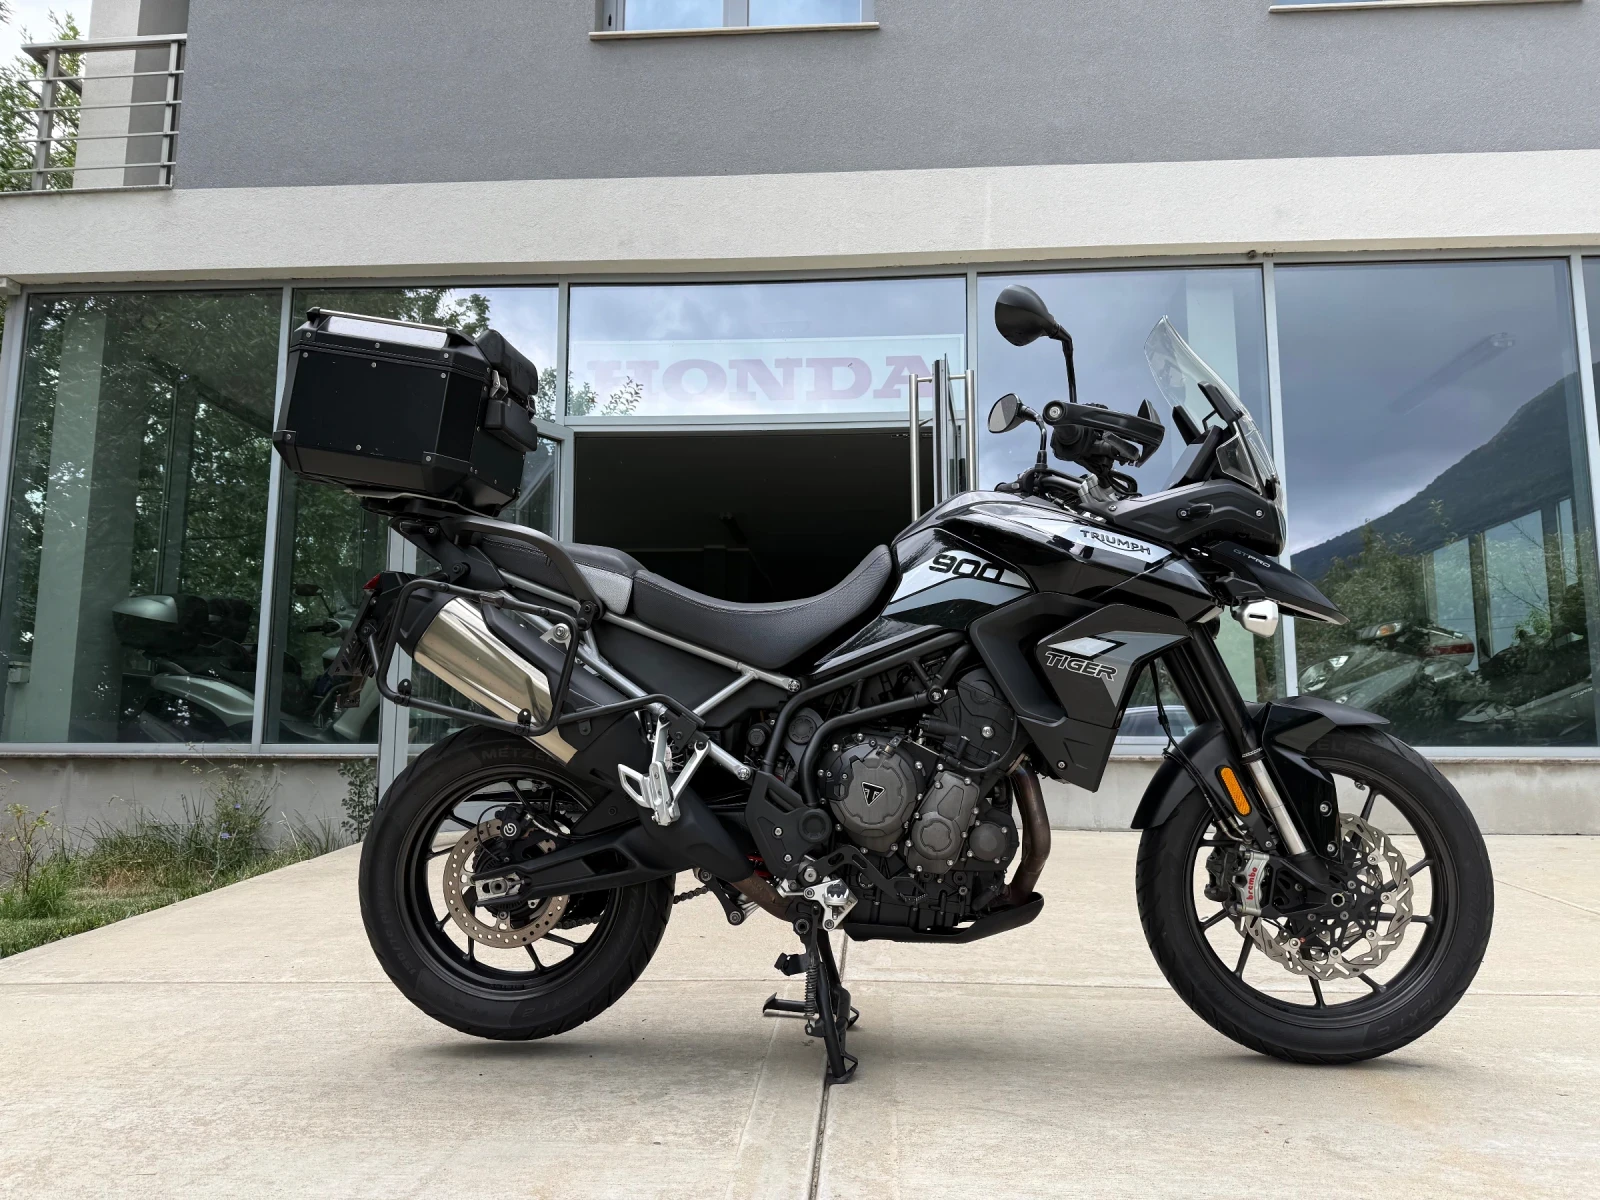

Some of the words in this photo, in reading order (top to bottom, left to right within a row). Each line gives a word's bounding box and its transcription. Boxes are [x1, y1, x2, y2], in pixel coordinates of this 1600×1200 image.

[586, 355, 934, 403] HONDA
[1080, 530, 1151, 555] TRIUMPH
[929, 553, 1004, 581] 900
[1045, 651, 1117, 681] TIGER
[1246, 867, 1258, 900] brembo
